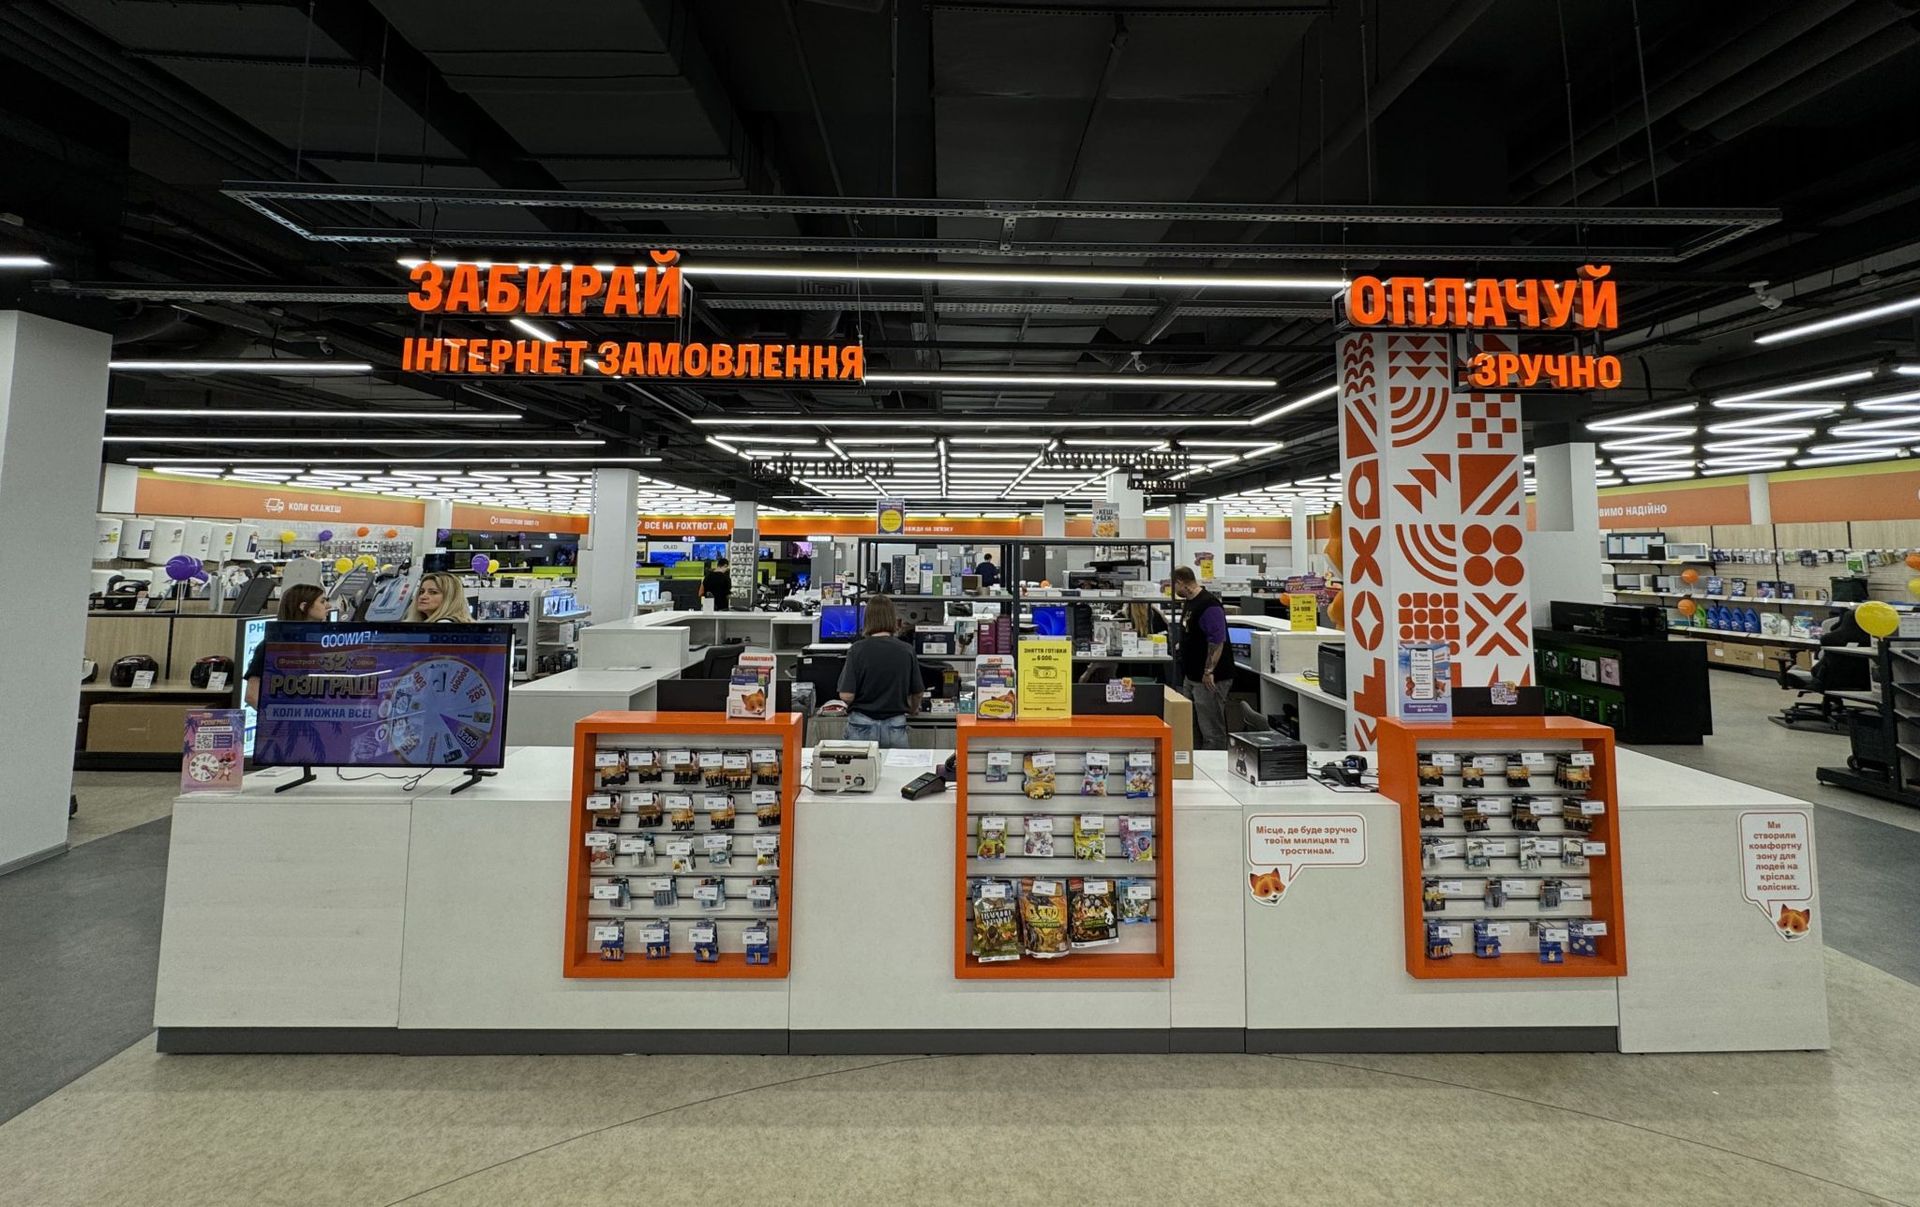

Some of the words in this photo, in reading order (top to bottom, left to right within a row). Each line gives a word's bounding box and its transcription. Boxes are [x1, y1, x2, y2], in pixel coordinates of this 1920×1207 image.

[407, 250, 683, 317] ЗАБИРАЙ
[1346, 265, 1618, 329] ОПЛАЧУЙ
[402, 337, 588, 374] ІНТЕРНЕТ
[598, 342, 864, 380] ЗАМОВЛЕННЯ
[1471, 352, 1622, 389] ЗРУЧНО
[1625, 502, 1668, 516] НАДІЙНО
[644, 521, 660, 530] ВСЕ
[662, 521, 674, 530] НА
[676, 521, 728, 531] FOXTROT.UA
[270, 674, 377, 697] РОЗІГРАШ
[272, 706, 302, 717] КОЛИ
[303, 707, 346, 718] МОЖНА
[347, 708, 372, 719] ВСЕ!
[1767, 821, 1781, 829] Ми
[1256, 826, 1286, 835] Місце,
[1287, 827, 1299, 835] де
[1300, 825, 1323, 835] буде
[1324, 826, 1358, 836] зручно
[1264, 836, 1292, 845] твоїм
[1293, 837, 1338, 845] милицям
[1753, 833, 1797, 841] створили
[1748, 842, 1802, 851] комфортну
[1280, 848, 1335, 856] тростинам.
[1756, 853, 1778, 861] зону
[1779, 853, 1796, 861] для
[1755, 862, 1786, 871] людей
[1760, 873, 1795, 882] кріслах
[1757, 883, 1801, 892] колісних.
